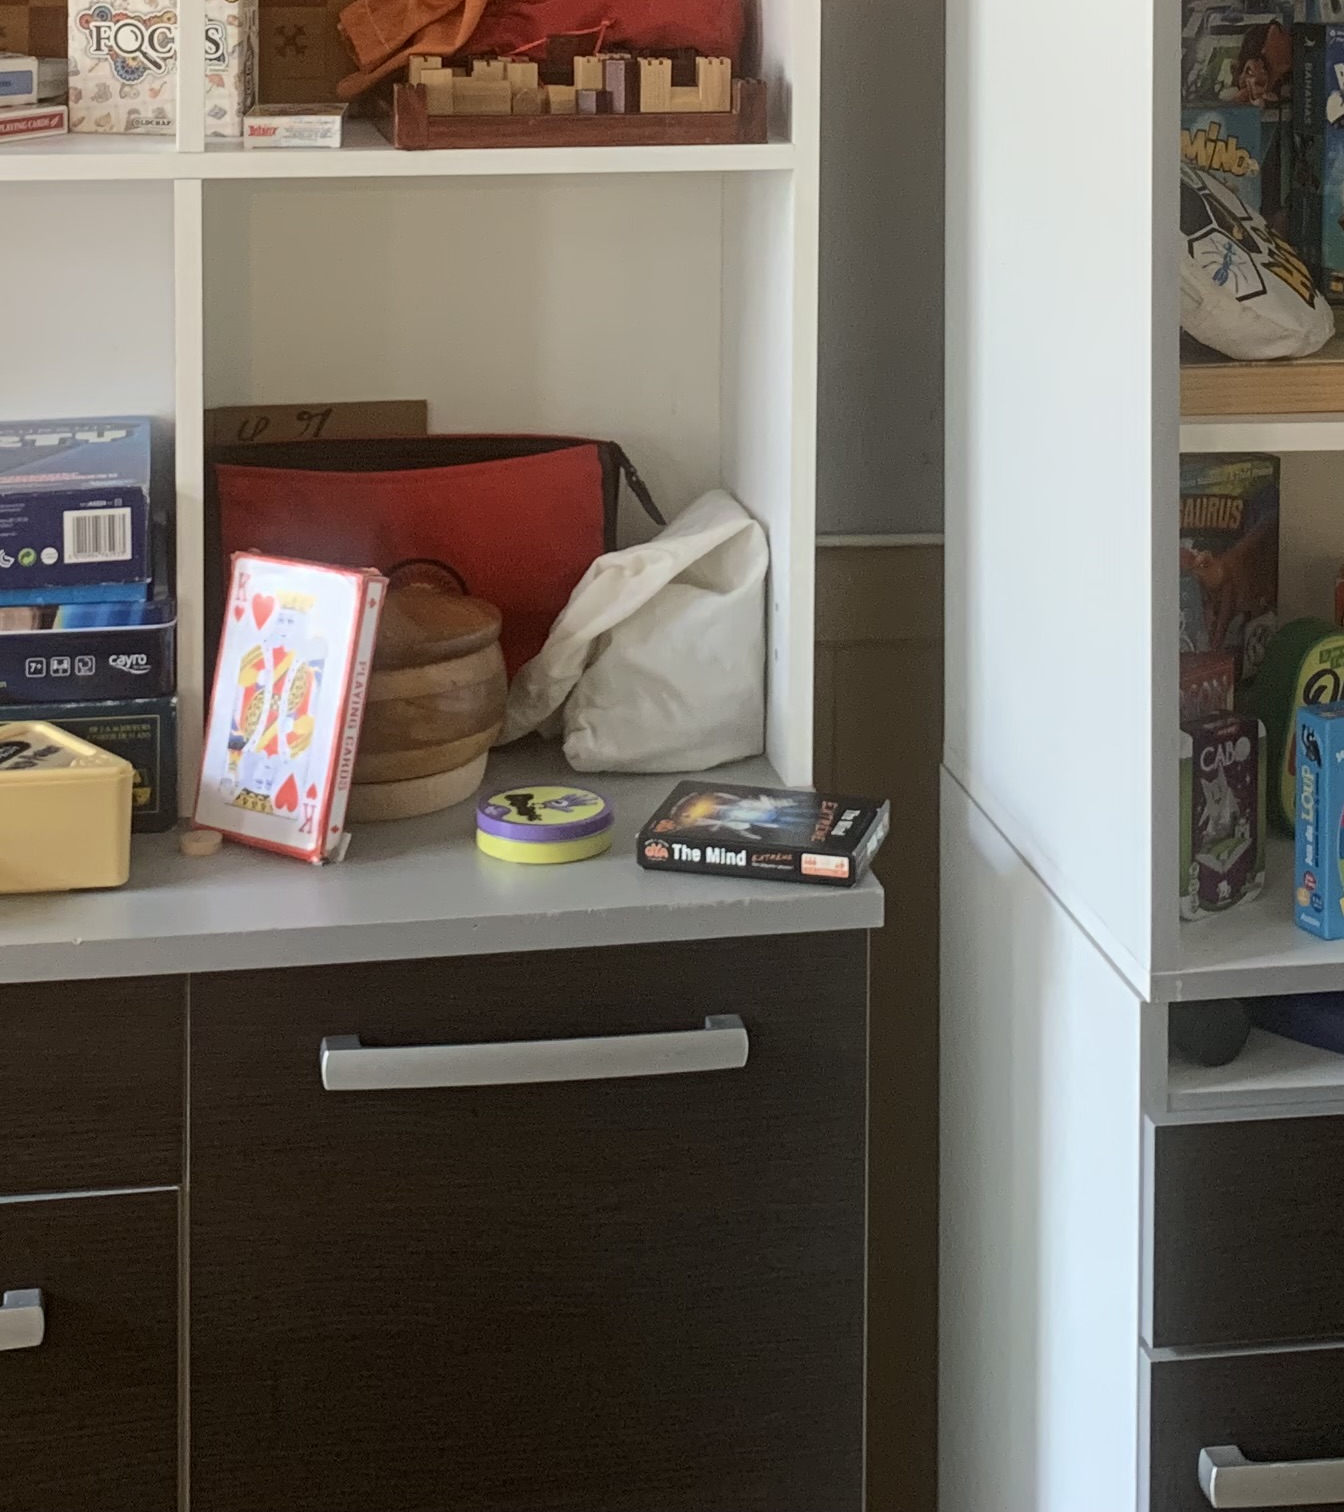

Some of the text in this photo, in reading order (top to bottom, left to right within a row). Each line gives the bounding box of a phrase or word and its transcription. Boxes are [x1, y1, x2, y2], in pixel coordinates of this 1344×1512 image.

[93, 21, 222, 71] FOCS
[28, 117, 50, 129] CARDS
[234, 572, 251, 602] K
[109, 654, 147, 668] cayro
[1200, 737, 1252, 771] CABO
[1301, 765, 1314, 820] LOUP
[297, 803, 317, 835] K
[672, 843, 747, 866] The Mind
